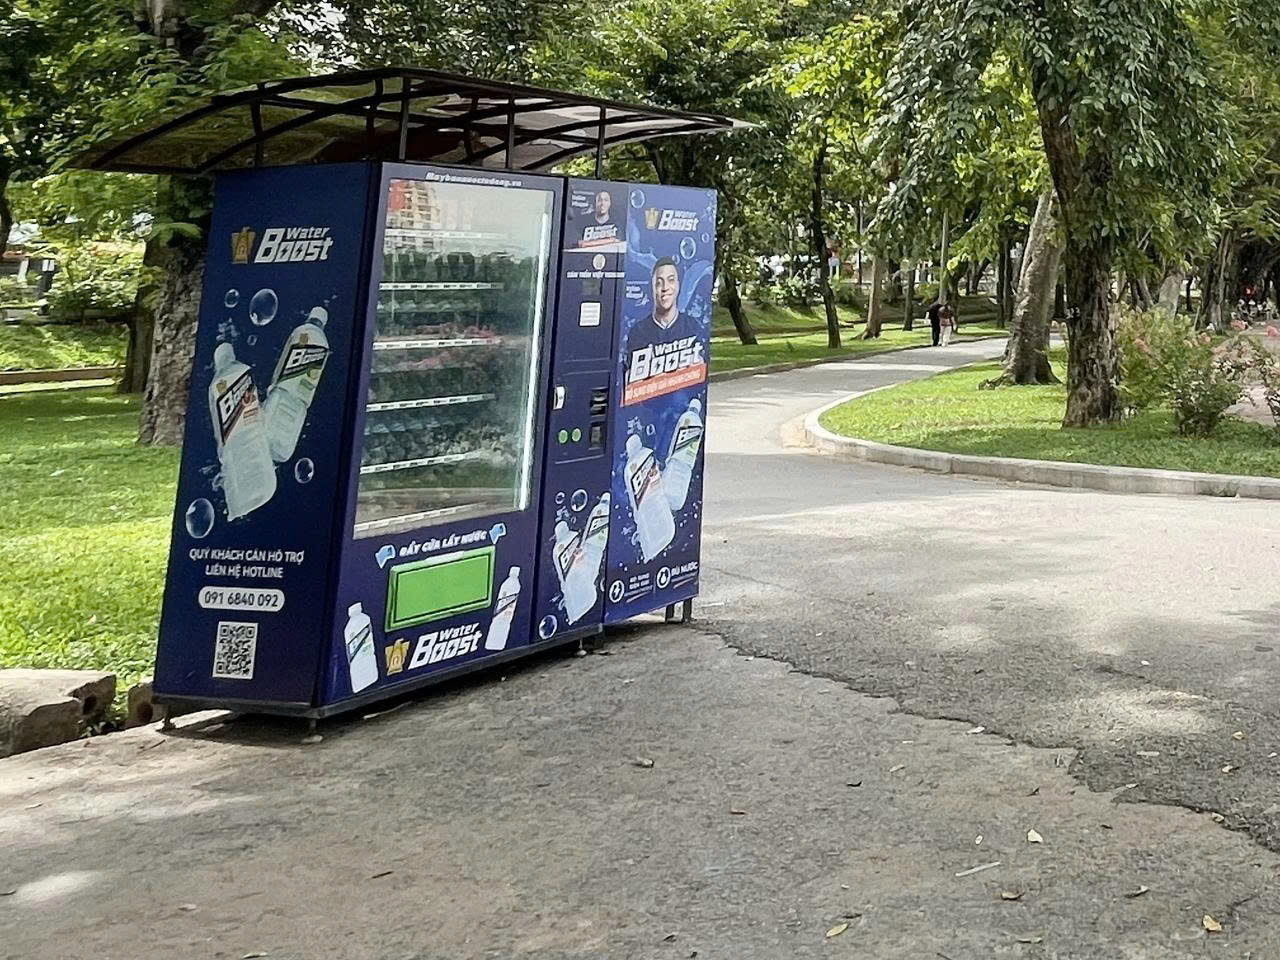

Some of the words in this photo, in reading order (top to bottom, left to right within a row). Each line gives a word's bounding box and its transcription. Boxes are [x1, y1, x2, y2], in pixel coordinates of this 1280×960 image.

[657, 209, 700, 231] Boost
[286, 227, 330, 240] Water
[254, 228, 334, 263] Boost
[654, 335, 697, 356] Water
[629, 342, 704, 383] Boost
[210, 547, 244, 561] KHÁCH
[284, 550, 305, 566] TRỢ
[205, 562, 227, 576] LIÊN
[228, 563, 241, 579] HỆ
[242, 566, 284, 578] HOTLINE
[204, 591, 224, 605] 091
[227, 592, 255, 606] 6840
[257, 593, 279, 607] 092
[439, 622, 480, 641] Water
[408, 630, 483, 670] Boost
